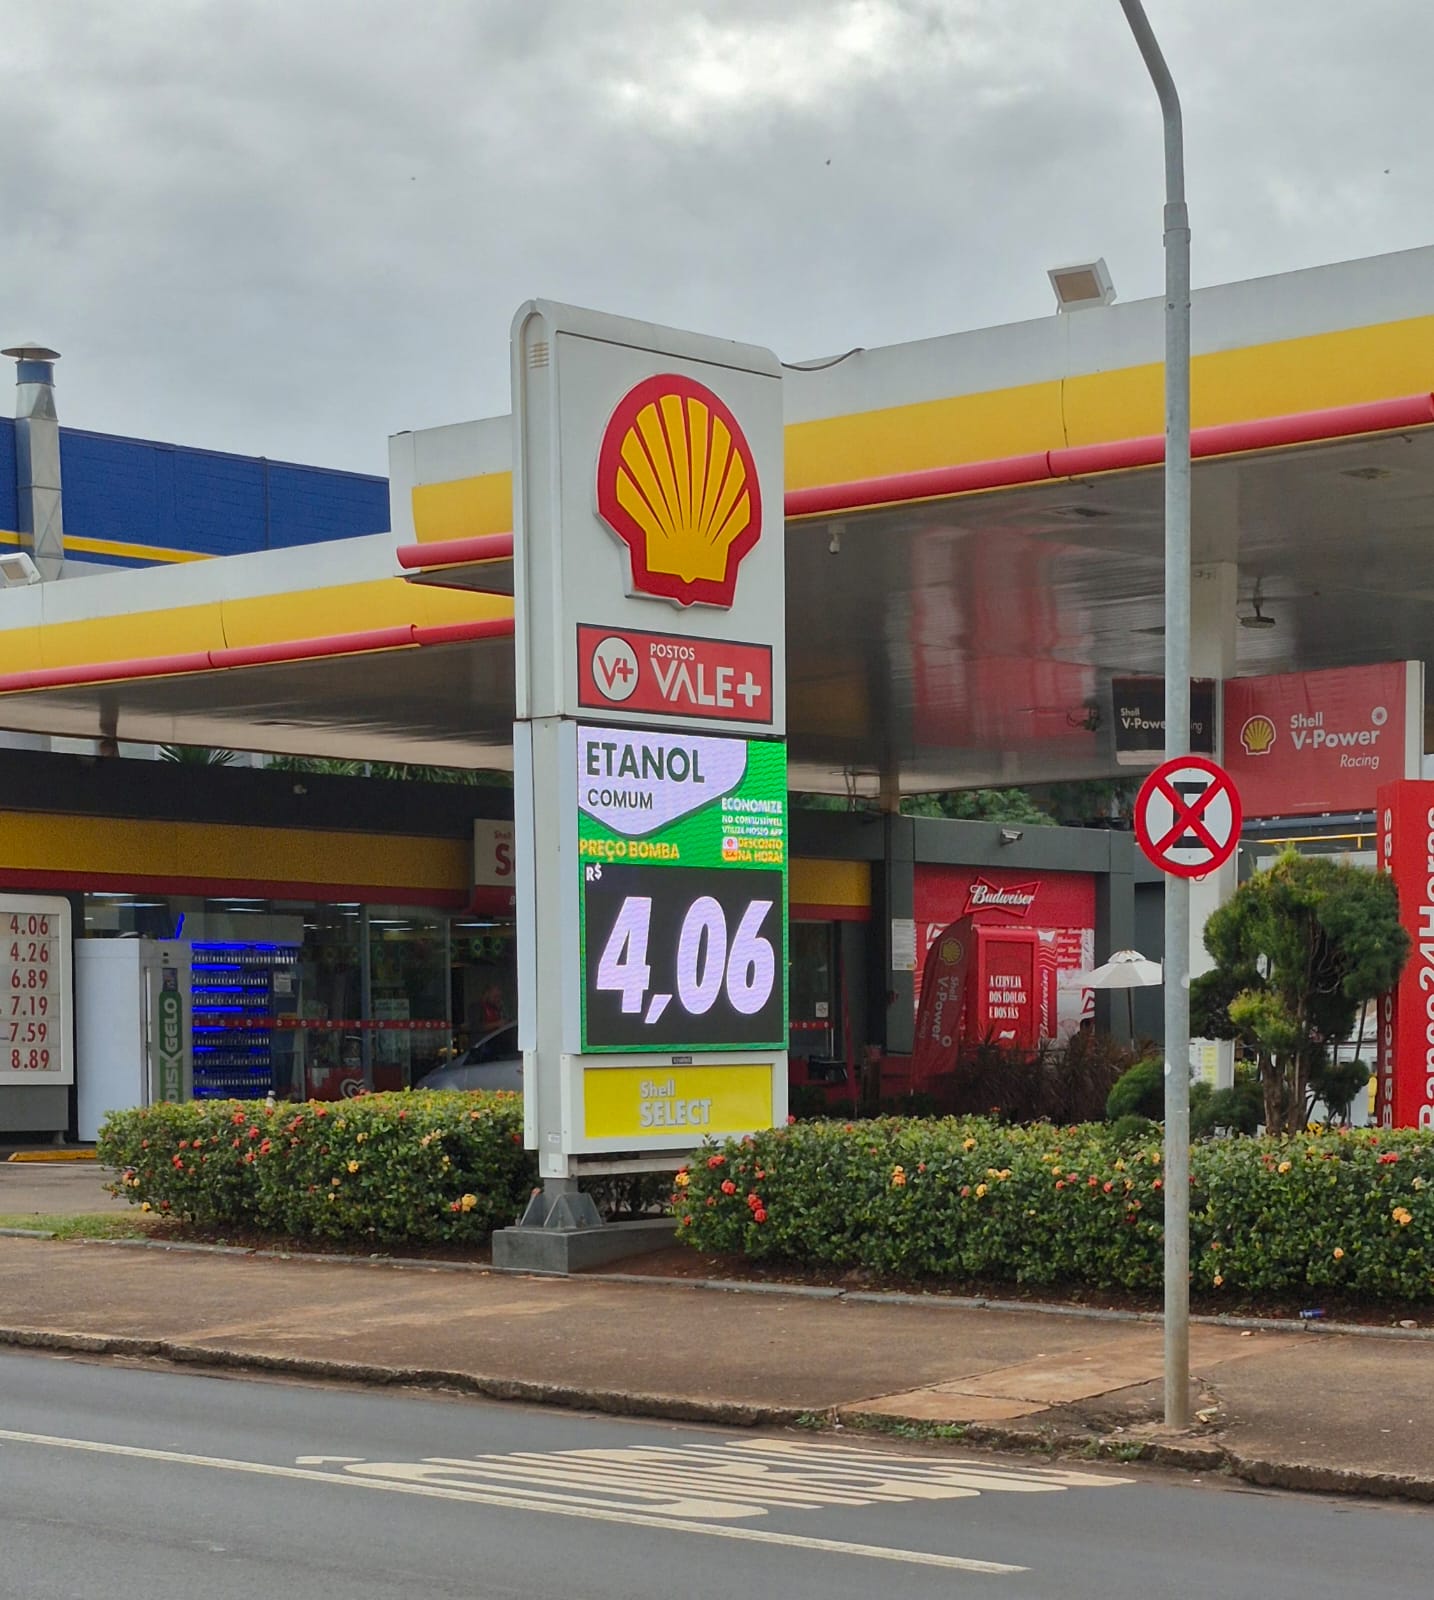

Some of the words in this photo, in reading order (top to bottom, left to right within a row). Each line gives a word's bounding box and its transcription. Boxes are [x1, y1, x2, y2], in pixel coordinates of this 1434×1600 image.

[650, 643, 695, 660] POSTOS
[597, 655, 634, 691] V+
[650, 657, 762, 708] VALE+
[1120, 707, 1141, 717] Shell
[1290, 711, 1323, 729] Shell
[1121, 717, 1166, 729] V-Powe
[1290, 729, 1381, 750] V-Power
[586, 741, 705, 783] ETANOL
[1340, 752, 1380, 770] Racing
[587, 789, 653, 810] COMUM
[721, 797, 783, 814] ECONOMIZE
[579, 839, 627, 862] PREÇO
[628, 841, 680, 859] BOMBA
[738, 837, 784, 850] DESCONTO
[738, 849, 752, 862] NA
[586, 862, 602, 881] R$
[970, 885, 1035, 904] Budweiser
[10, 915, 49, 935] 4.06
[10, 942, 49, 962] 4.26
[596, 895, 775, 1024] 4,06
[11, 969, 48, 989] 6.89
[995, 975, 1022, 988] CERVEJA
[11, 996, 48, 1016] 7.19
[989, 991, 1002, 1003] DOS
[10, 1022, 47, 1042] 7.59
[11, 1049, 50, 1069] 8.89
[640, 1079, 676, 1099] Shell
[640, 1098, 713, 1127] SELECT
